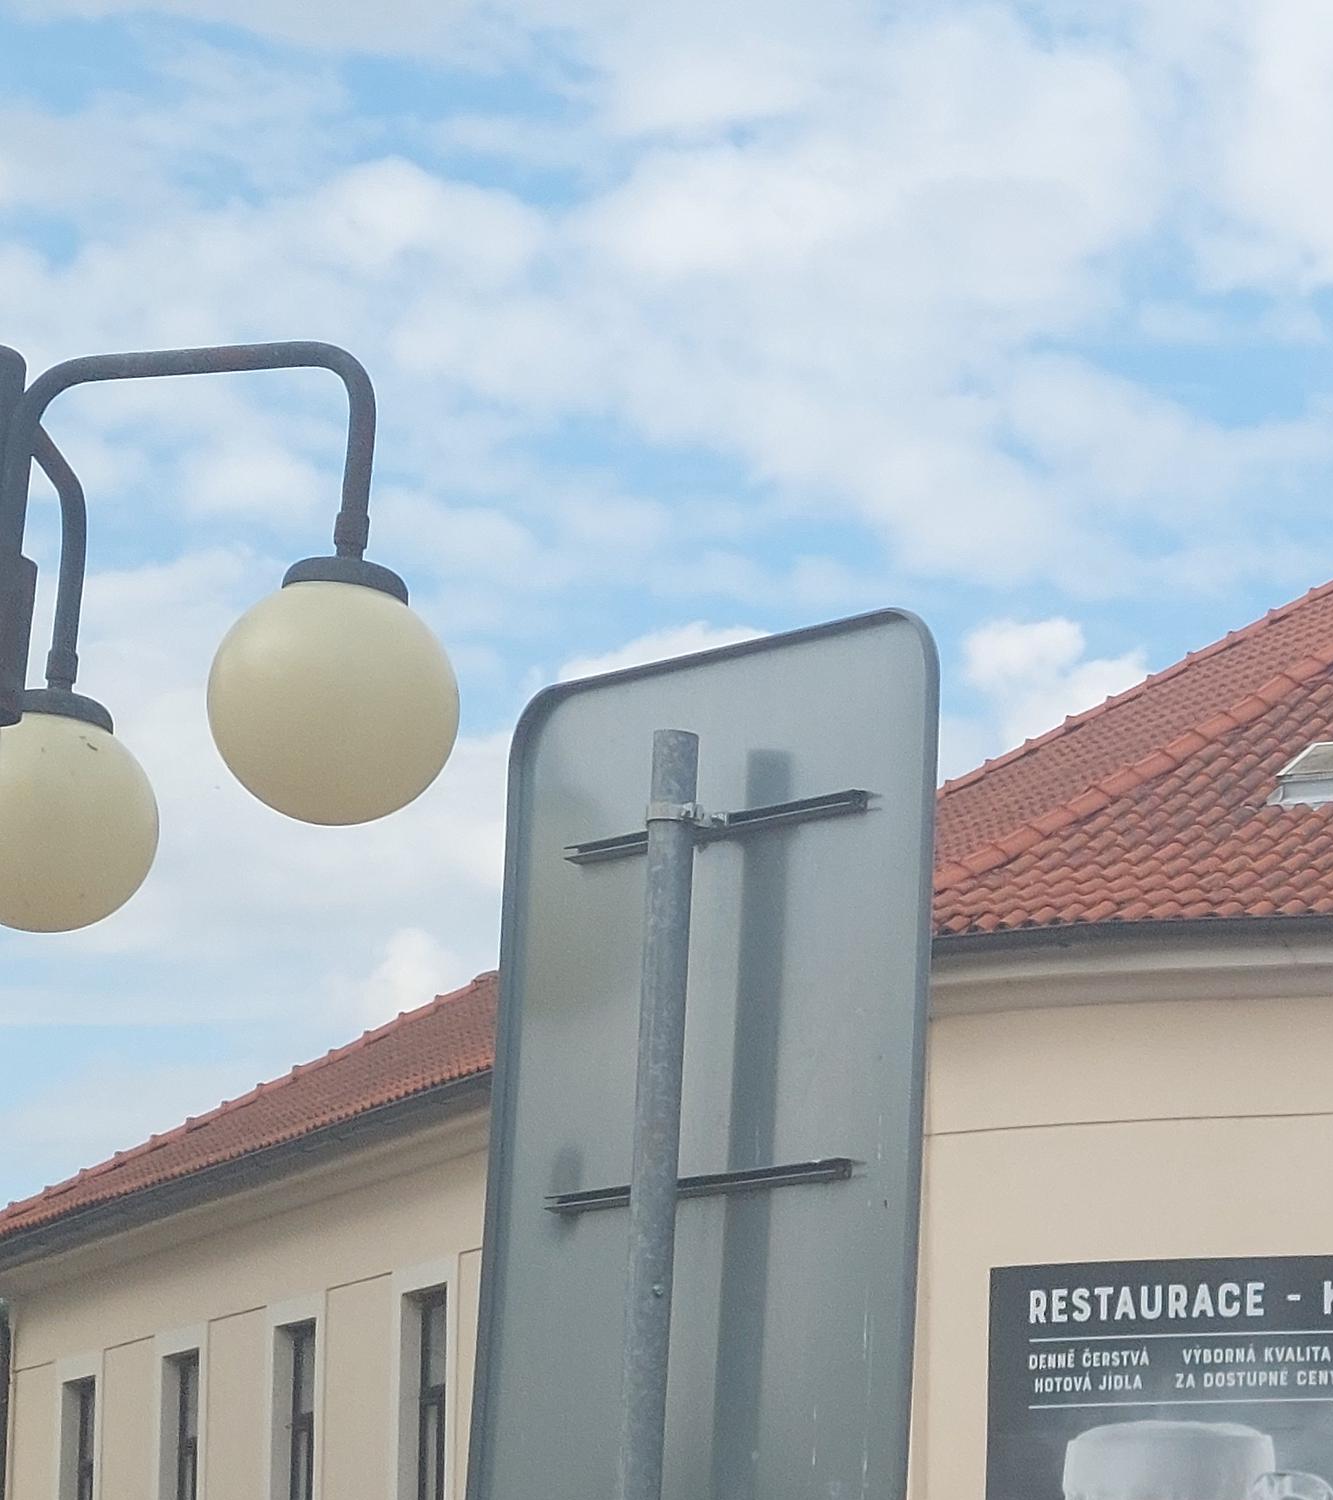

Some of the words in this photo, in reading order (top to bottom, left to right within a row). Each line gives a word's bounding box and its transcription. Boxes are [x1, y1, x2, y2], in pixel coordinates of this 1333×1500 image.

[1029, 1282, 1266, 1324] RESTAURACE
[1028, 1349, 1075, 1370] DENNĚ
[1082, 1346, 1150, 1367] ČERSTVÁ
[1182, 1344, 1256, 1364] VÝBORNÁ
[1264, 1347, 1332, 1363] KVALITA
[1034, 1371, 1092, 1393] HOTOVÁ
[1098, 1370, 1143, 1391] JÍDLA
[1174, 1372, 1196, 1389] ZA
[1203, 1367, 1289, 1388] DOSTUPNÉ
